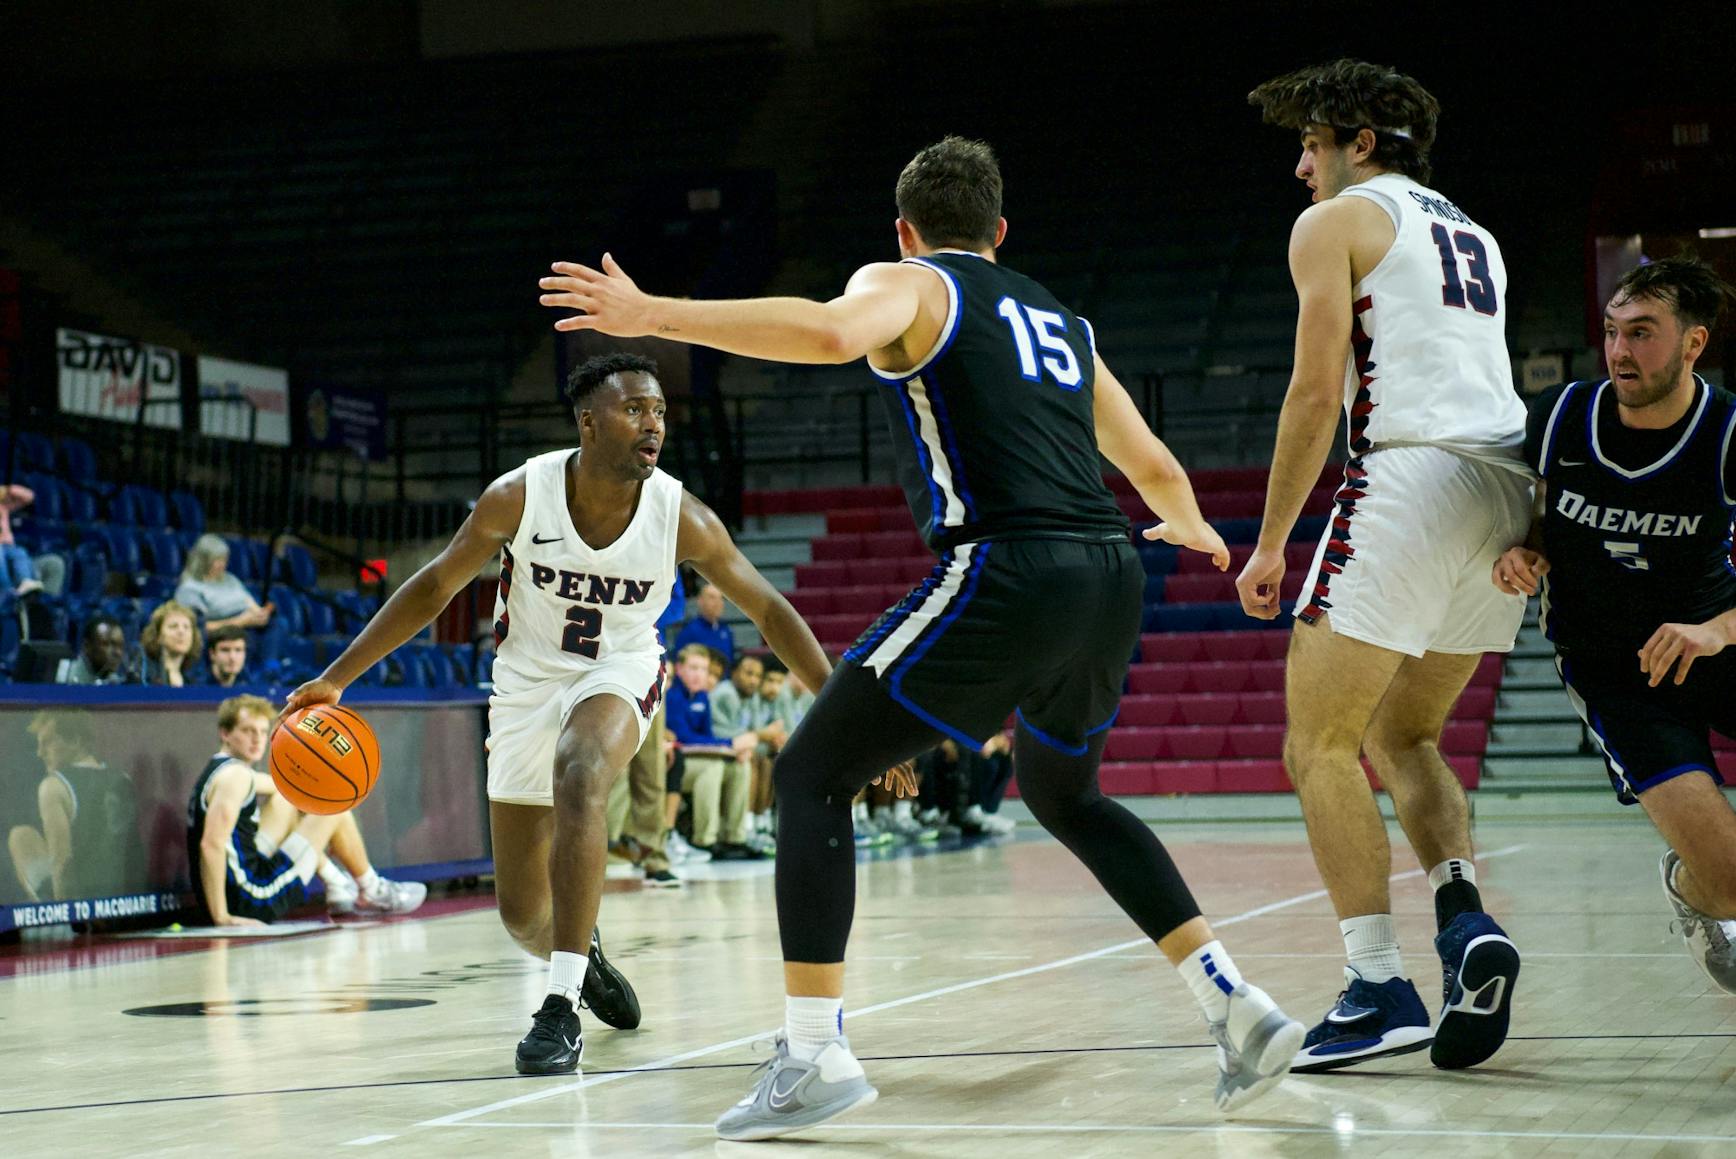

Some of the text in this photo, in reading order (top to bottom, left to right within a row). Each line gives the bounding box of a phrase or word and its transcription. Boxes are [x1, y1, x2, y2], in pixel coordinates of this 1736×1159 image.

[1430, 221, 1498, 318] 13
[996, 294, 1085, 393] 15
[1555, 488, 1703, 537] DAEMEN
[530, 561, 656, 605] PENN
[560, 605, 603, 661] 2
[301, 711, 352, 757] ELITE
[12, 903, 70, 927] WELCOME
[74, 901, 91, 920] TO
[94, 894, 157, 916] MACQUARIE
